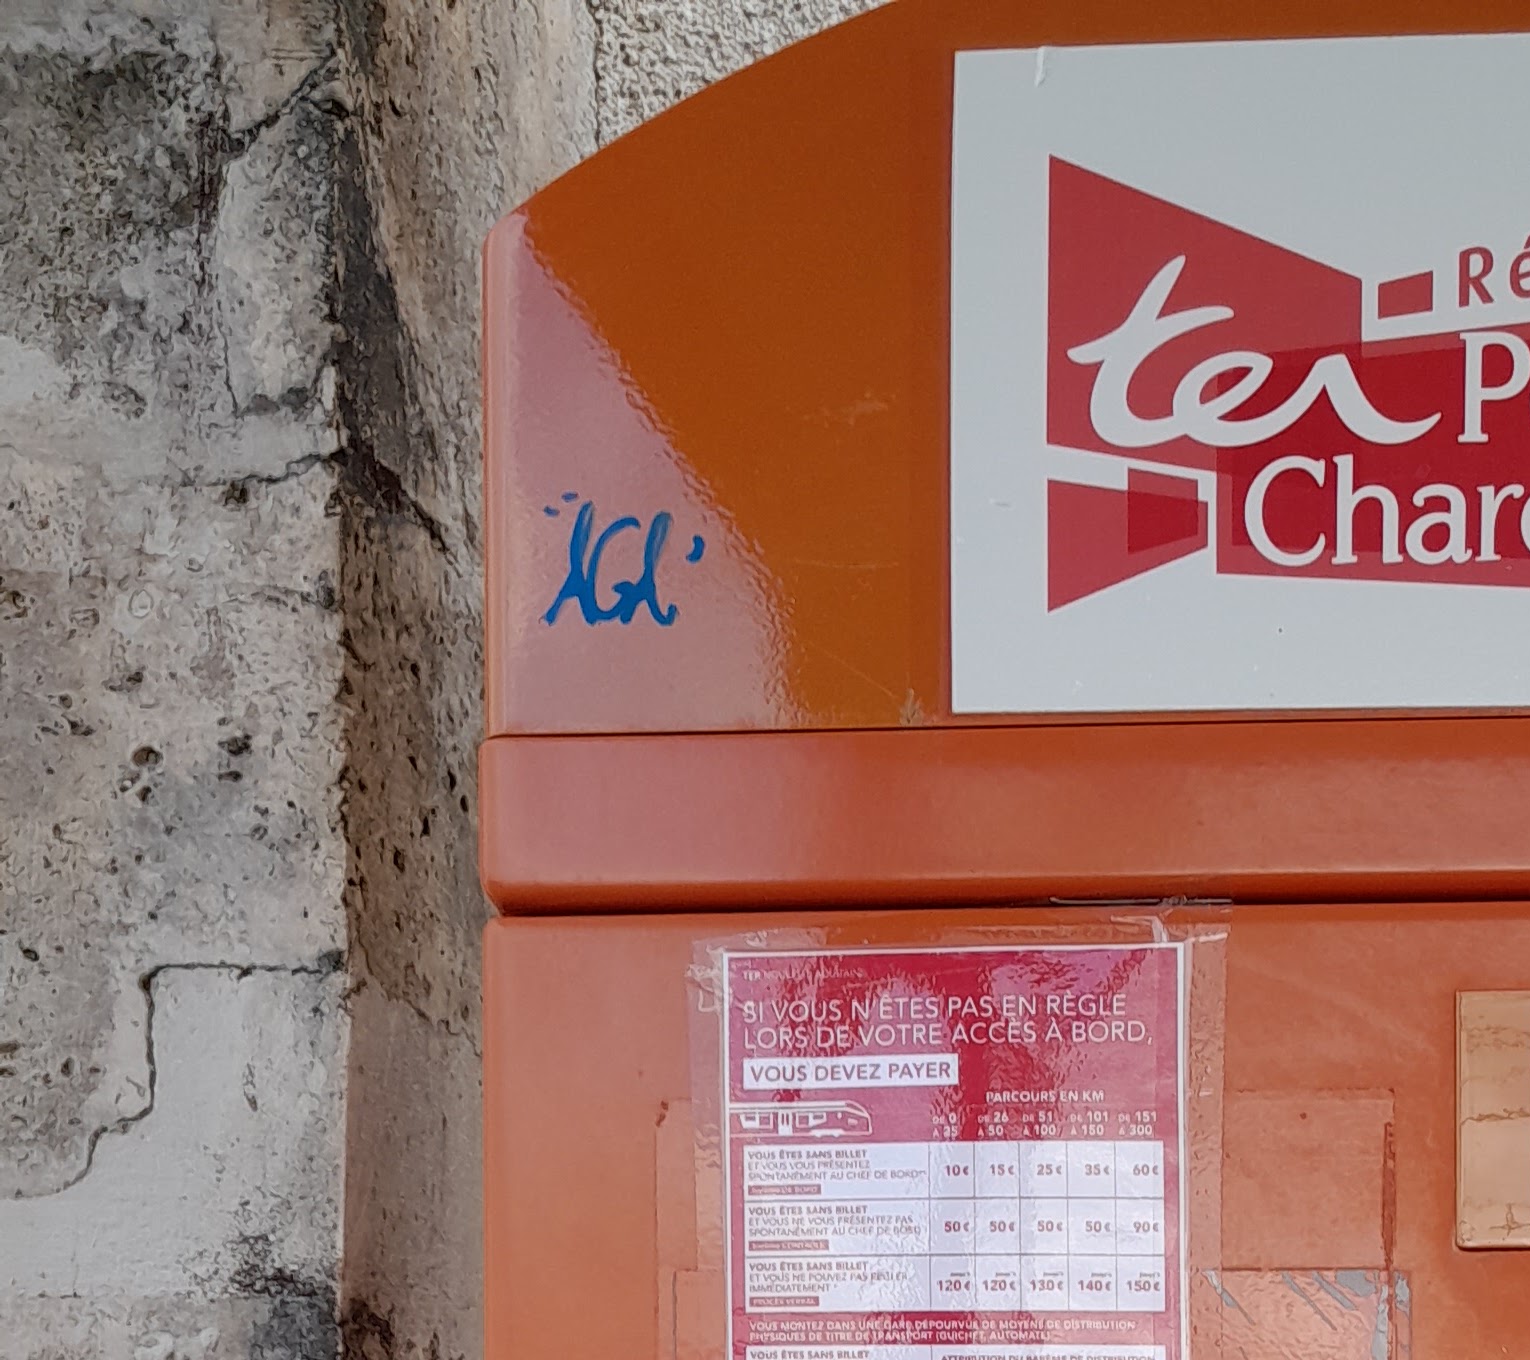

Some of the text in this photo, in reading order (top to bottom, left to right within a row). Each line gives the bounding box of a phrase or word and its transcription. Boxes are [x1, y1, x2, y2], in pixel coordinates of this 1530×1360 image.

[1065, 254, 1443, 449] ter
[743, 989, 1126, 1023] SI VOUS N'ÊTES PAS EN RÈGLE
[744, 1017, 1152, 1049] LORS DE VOTRE ACCÈS À BORD,
[750, 1061, 950, 1082] VOUS DEVEZ PAYER
[986, 1089, 1104, 1103] PARCOURS EN KM
[949, 1113, 957, 1124] 0
[994, 1112, 1008, 1122] 26
[1038, 1111, 1053, 1122] 51
[1087, 1111, 1108, 1122] 101
[1135, 1111, 1157, 1122] 151
[943, 1126, 958, 1136] 25
[988, 1126, 1004, 1136] 50
[1034, 1125, 1057, 1136] 100
[1081, 1125, 1104, 1136] 150
[1130, 1125, 1152, 1136] 300
[749, 1149, 867, 1160] VOUS ÊTES SANS BILLET
[749, 1205, 867, 1215] VOUS ÊTES SANS BILLET
